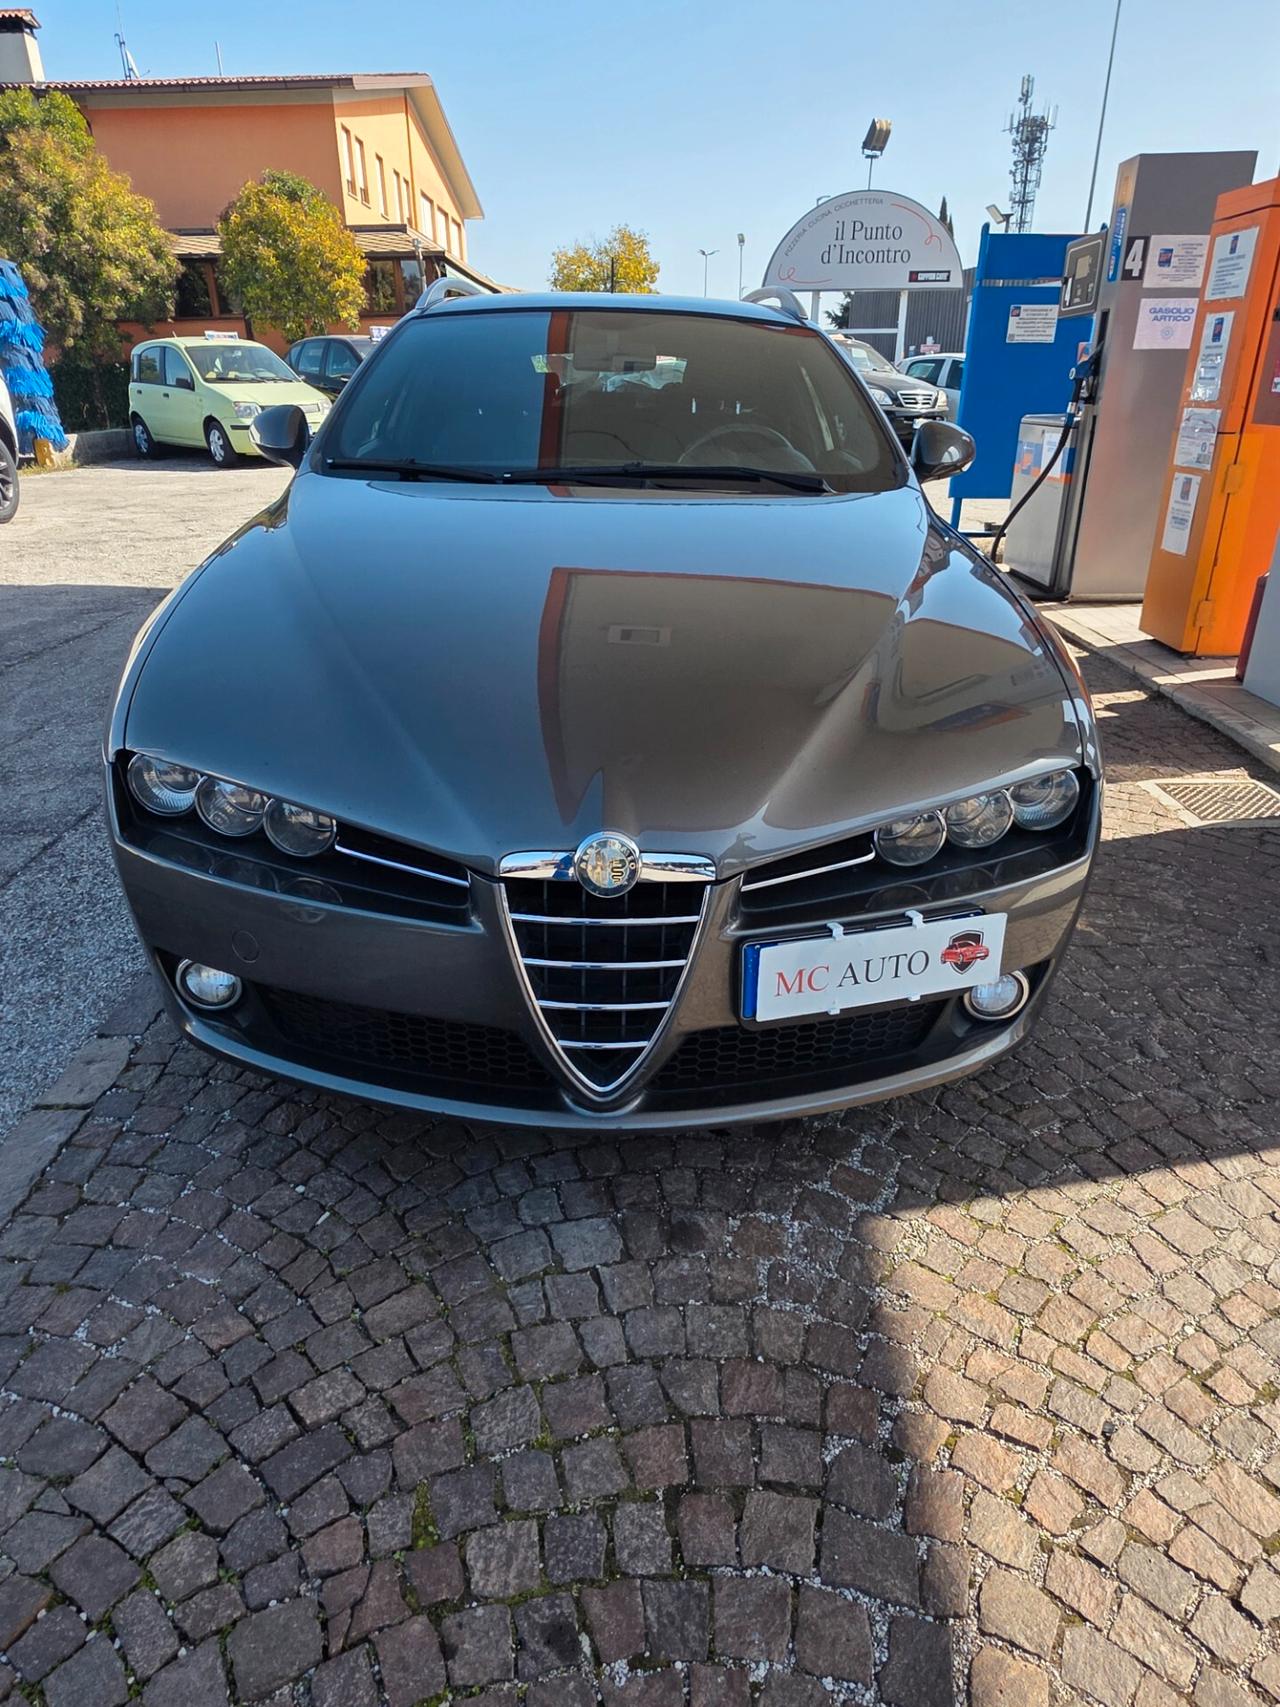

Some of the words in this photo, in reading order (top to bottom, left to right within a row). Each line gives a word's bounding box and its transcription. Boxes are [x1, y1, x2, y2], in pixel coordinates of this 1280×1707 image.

[785, 229, 807, 256] PIZZERIA
[808, 210, 832, 228] CUCINA
[835, 220, 845, 241] il
[851, 220, 903, 241] Punto
[820, 244, 911, 264] d'Incontro
[1125, 239, 1145, 277] 4
[1149, 307, 1195, 315] GASOLIO
[775, 965, 830, 997] MC
[836, 950, 930, 988] AUTO
